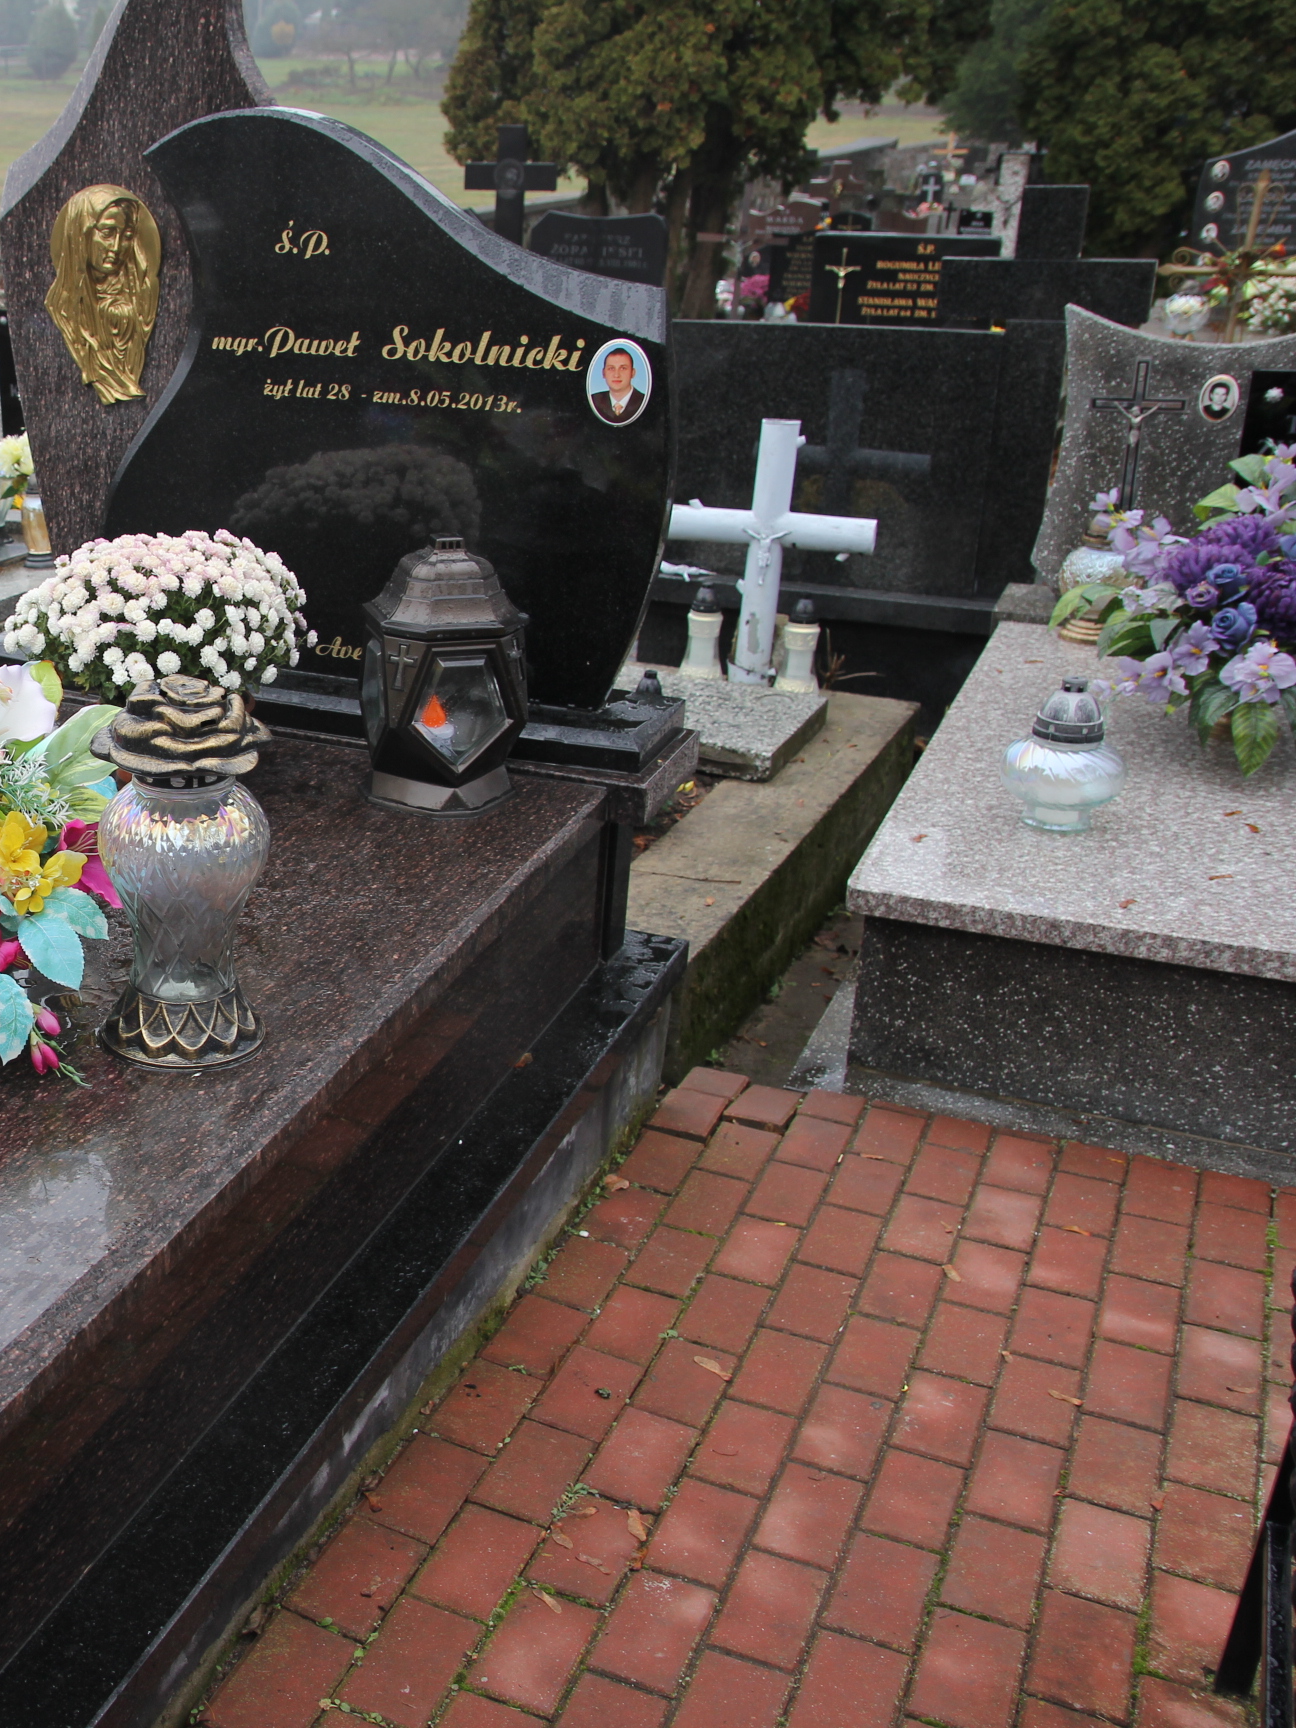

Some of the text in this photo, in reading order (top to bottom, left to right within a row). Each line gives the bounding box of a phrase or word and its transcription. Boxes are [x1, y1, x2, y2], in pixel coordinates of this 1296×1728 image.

[888, 281, 906, 290] LAT
[883, 307, 900, 316] LAT
[264, 326, 361, 358] Paweł
[381, 325, 587, 372] Sokolnicki
[263, 378, 294, 399] żył
[296, 379, 323, 399] lat
[326, 383, 351, 401] 28
[315, 636, 363, 660] Ave
